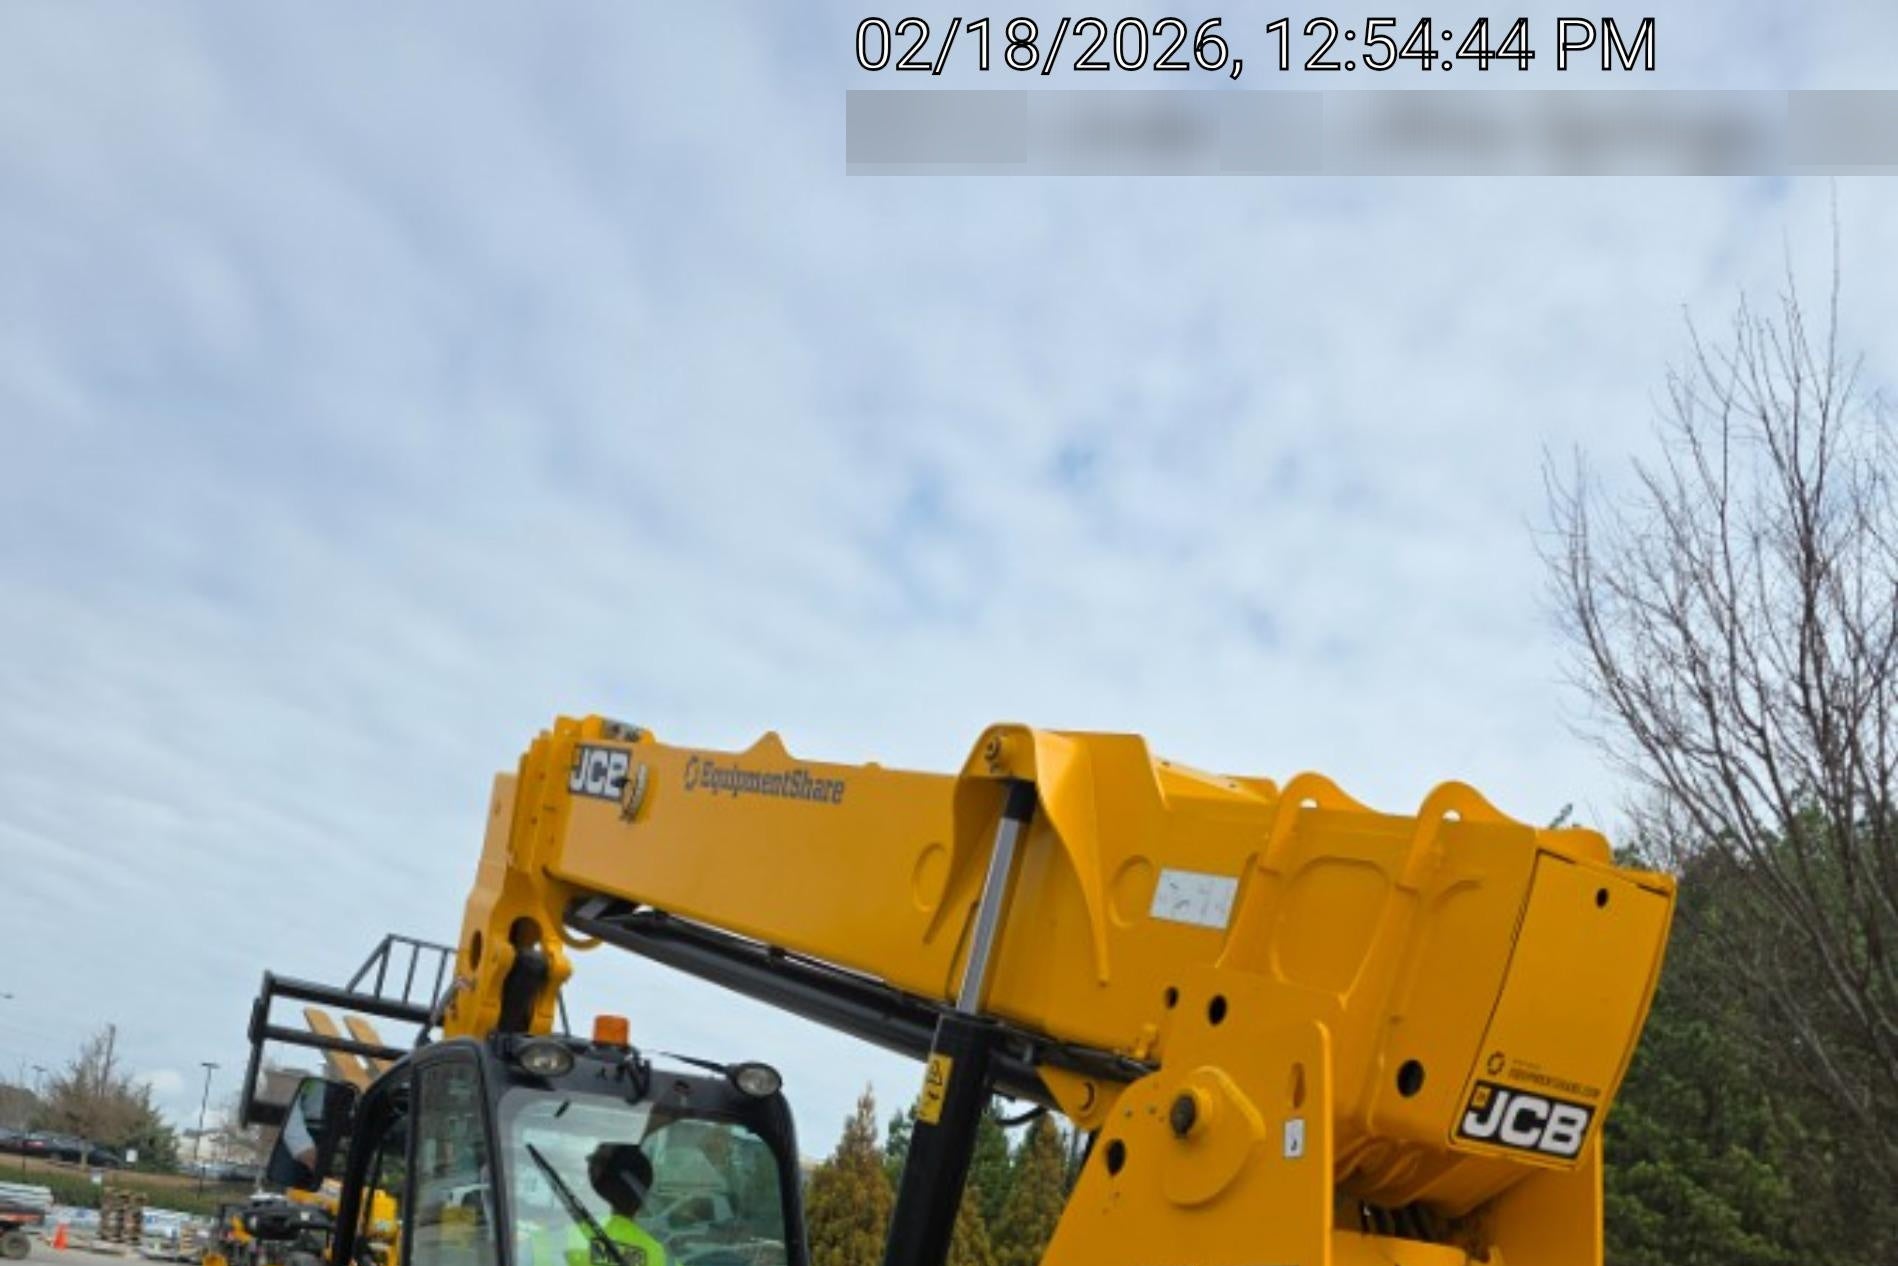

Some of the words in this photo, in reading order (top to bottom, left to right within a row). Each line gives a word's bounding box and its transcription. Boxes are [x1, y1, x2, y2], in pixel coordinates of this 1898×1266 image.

[570, 746, 629, 798] JCB
[701, 760, 845, 805] EquipmentShare
[1462, 1089, 1591, 1156] JCB
